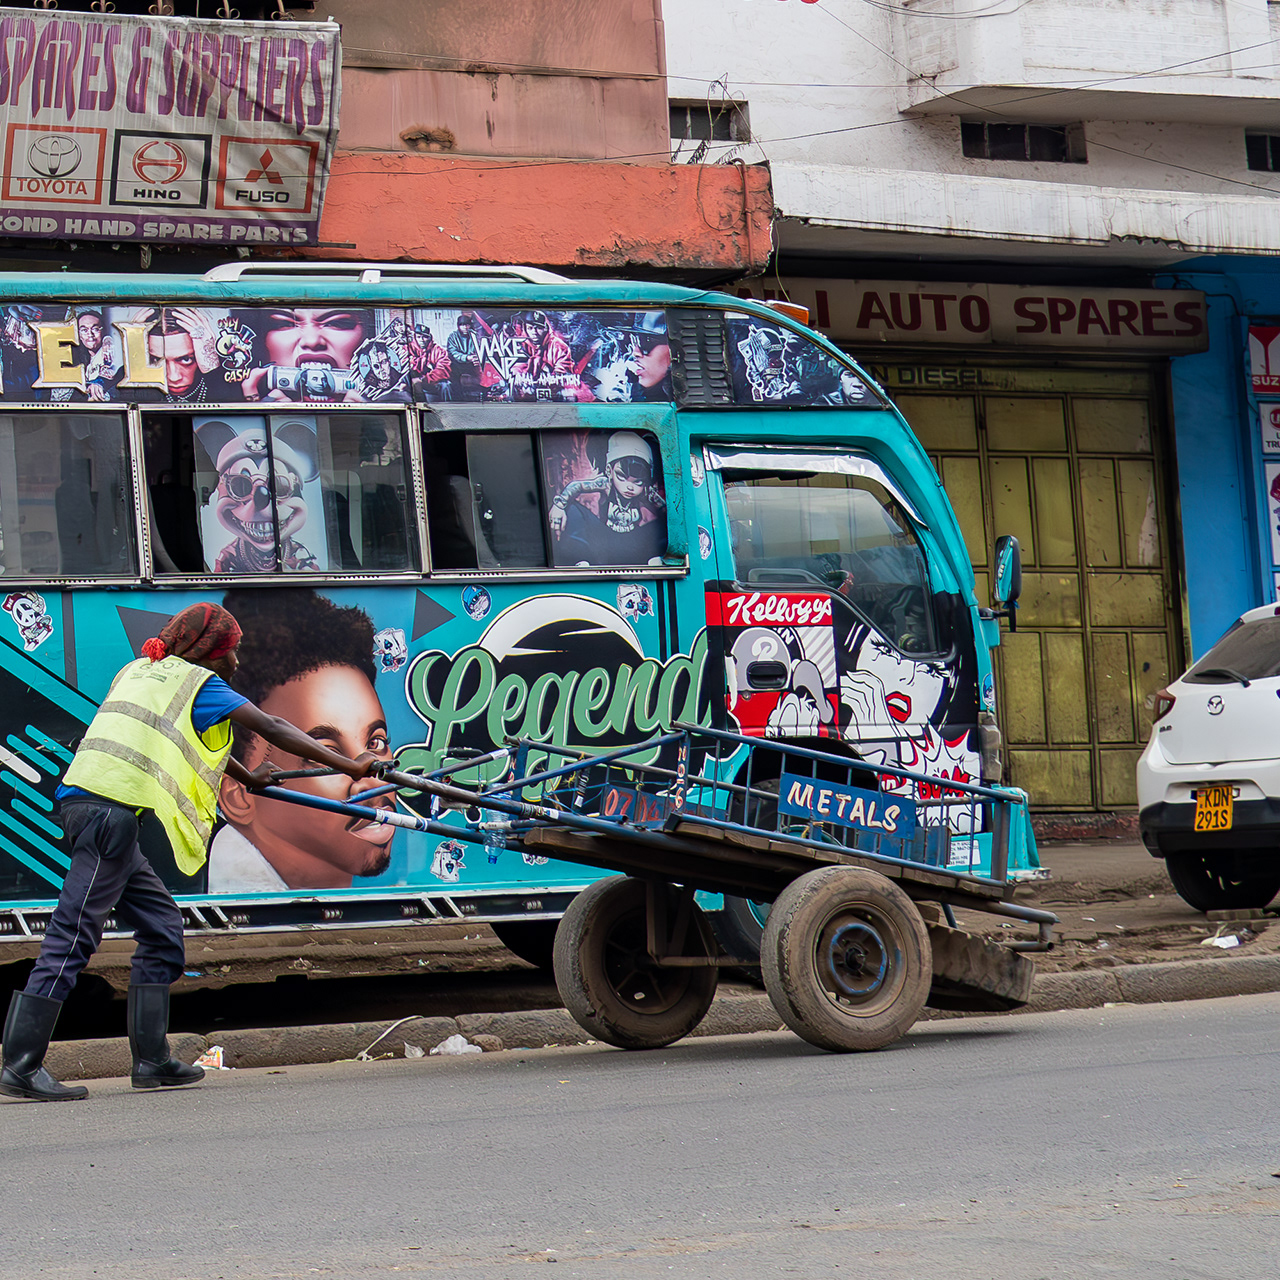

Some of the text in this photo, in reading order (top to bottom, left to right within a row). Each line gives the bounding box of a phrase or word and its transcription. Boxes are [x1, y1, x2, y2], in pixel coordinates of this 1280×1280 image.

[126, 25, 152, 115] &
[157, 29, 328, 136] SUPPLIERS
[16, 176, 88, 196] TOYOTA
[133, 188, 181, 201] HINO
[235, 189, 290, 204] FUSO
[65, 218, 136, 236] HAND
[143, 222, 224, 240] SPARE
[229, 225, 309, 243] PARTS
[855, 291, 990, 333] AUTO
[1014, 297, 1202, 338] SPARES
[471, 328, 529, 368] WAKE
[898, 366, 993, 386] DIESEL
[396, 628, 713, 802] Legend
[787, 781, 902, 833] METALS
[1204, 787, 1230, 808] KDN
[1197, 809, 1229, 830] 291S
